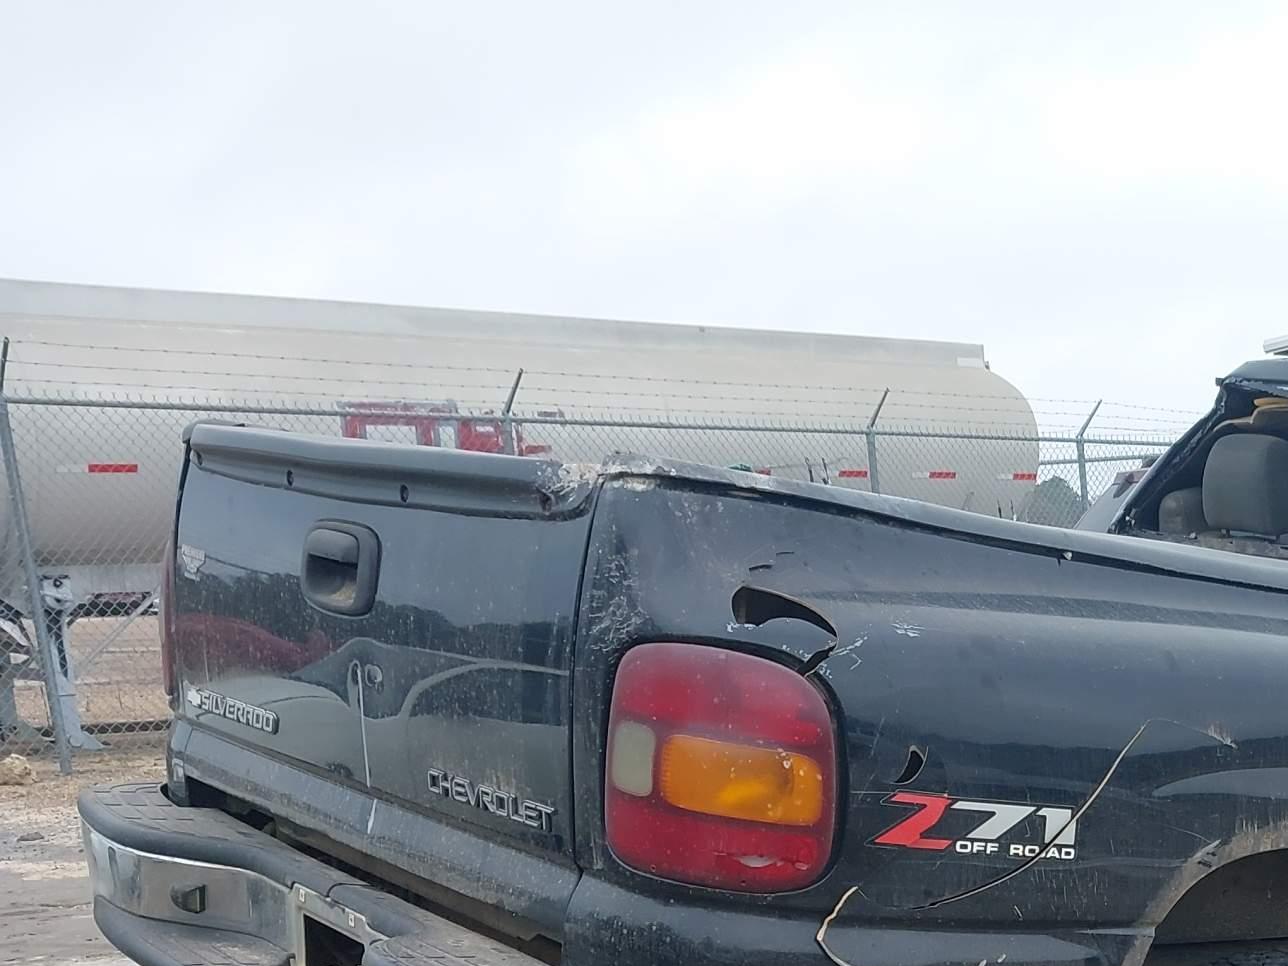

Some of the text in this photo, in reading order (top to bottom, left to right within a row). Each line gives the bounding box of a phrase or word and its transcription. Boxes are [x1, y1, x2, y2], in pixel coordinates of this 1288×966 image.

[200, 690, 275, 733] SILVERADO
[427, 768, 556, 832] CHEVROLET
[874, 792, 1077, 849] Z71
[955, 840, 1075, 860] OFF ROAD
